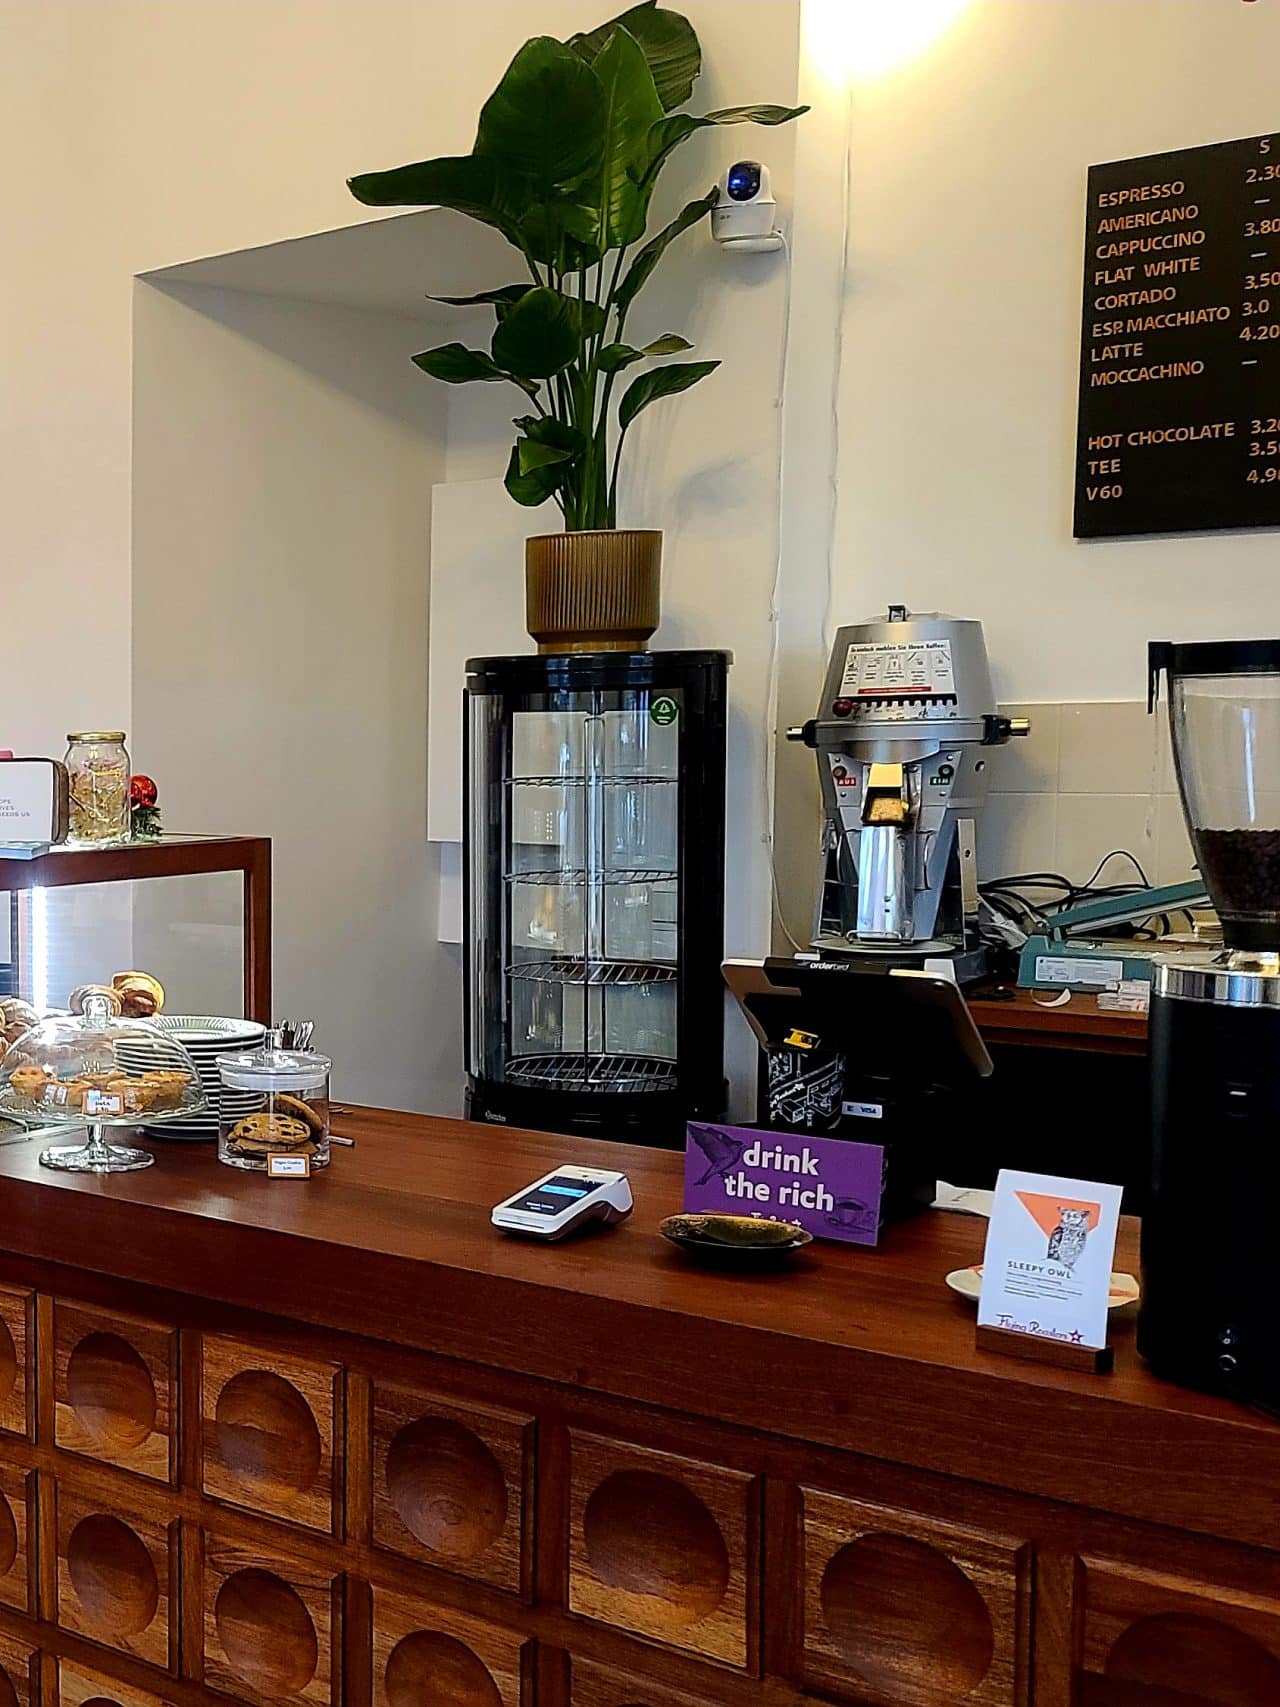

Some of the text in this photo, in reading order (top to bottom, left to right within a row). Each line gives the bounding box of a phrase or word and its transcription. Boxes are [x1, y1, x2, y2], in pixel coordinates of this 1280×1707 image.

[1259, 139, 1270, 154] S
[1098, 181, 1184, 208] ESPRESSO
[1097, 205, 1199, 233] AMERICANO
[1096, 230, 1205, 259] CAPPUCCINO
[1095, 257, 1200, 286] FLAT WHITE
[1094, 287, 1176, 310] CORTADO
[1127, 306, 1230, 333] MACCHIATO
[1242, 299, 1269, 316] 3.0
[1092, 325, 1280, 362] LATTE 4.20
[1091, 361, 1204, 387] MOCCACHINO
[1088, 419, 1280, 451] HOT CHOCOLATE 3.2
[1088, 441, 1280, 475] TEE 3.5
[1087, 468, 1280, 500] V60 4.9
[742, 1142, 820, 1176] drink
[724, 1173, 834, 1213] the rich
[1008, 1261, 1071, 1279] SLEEPY OWL
